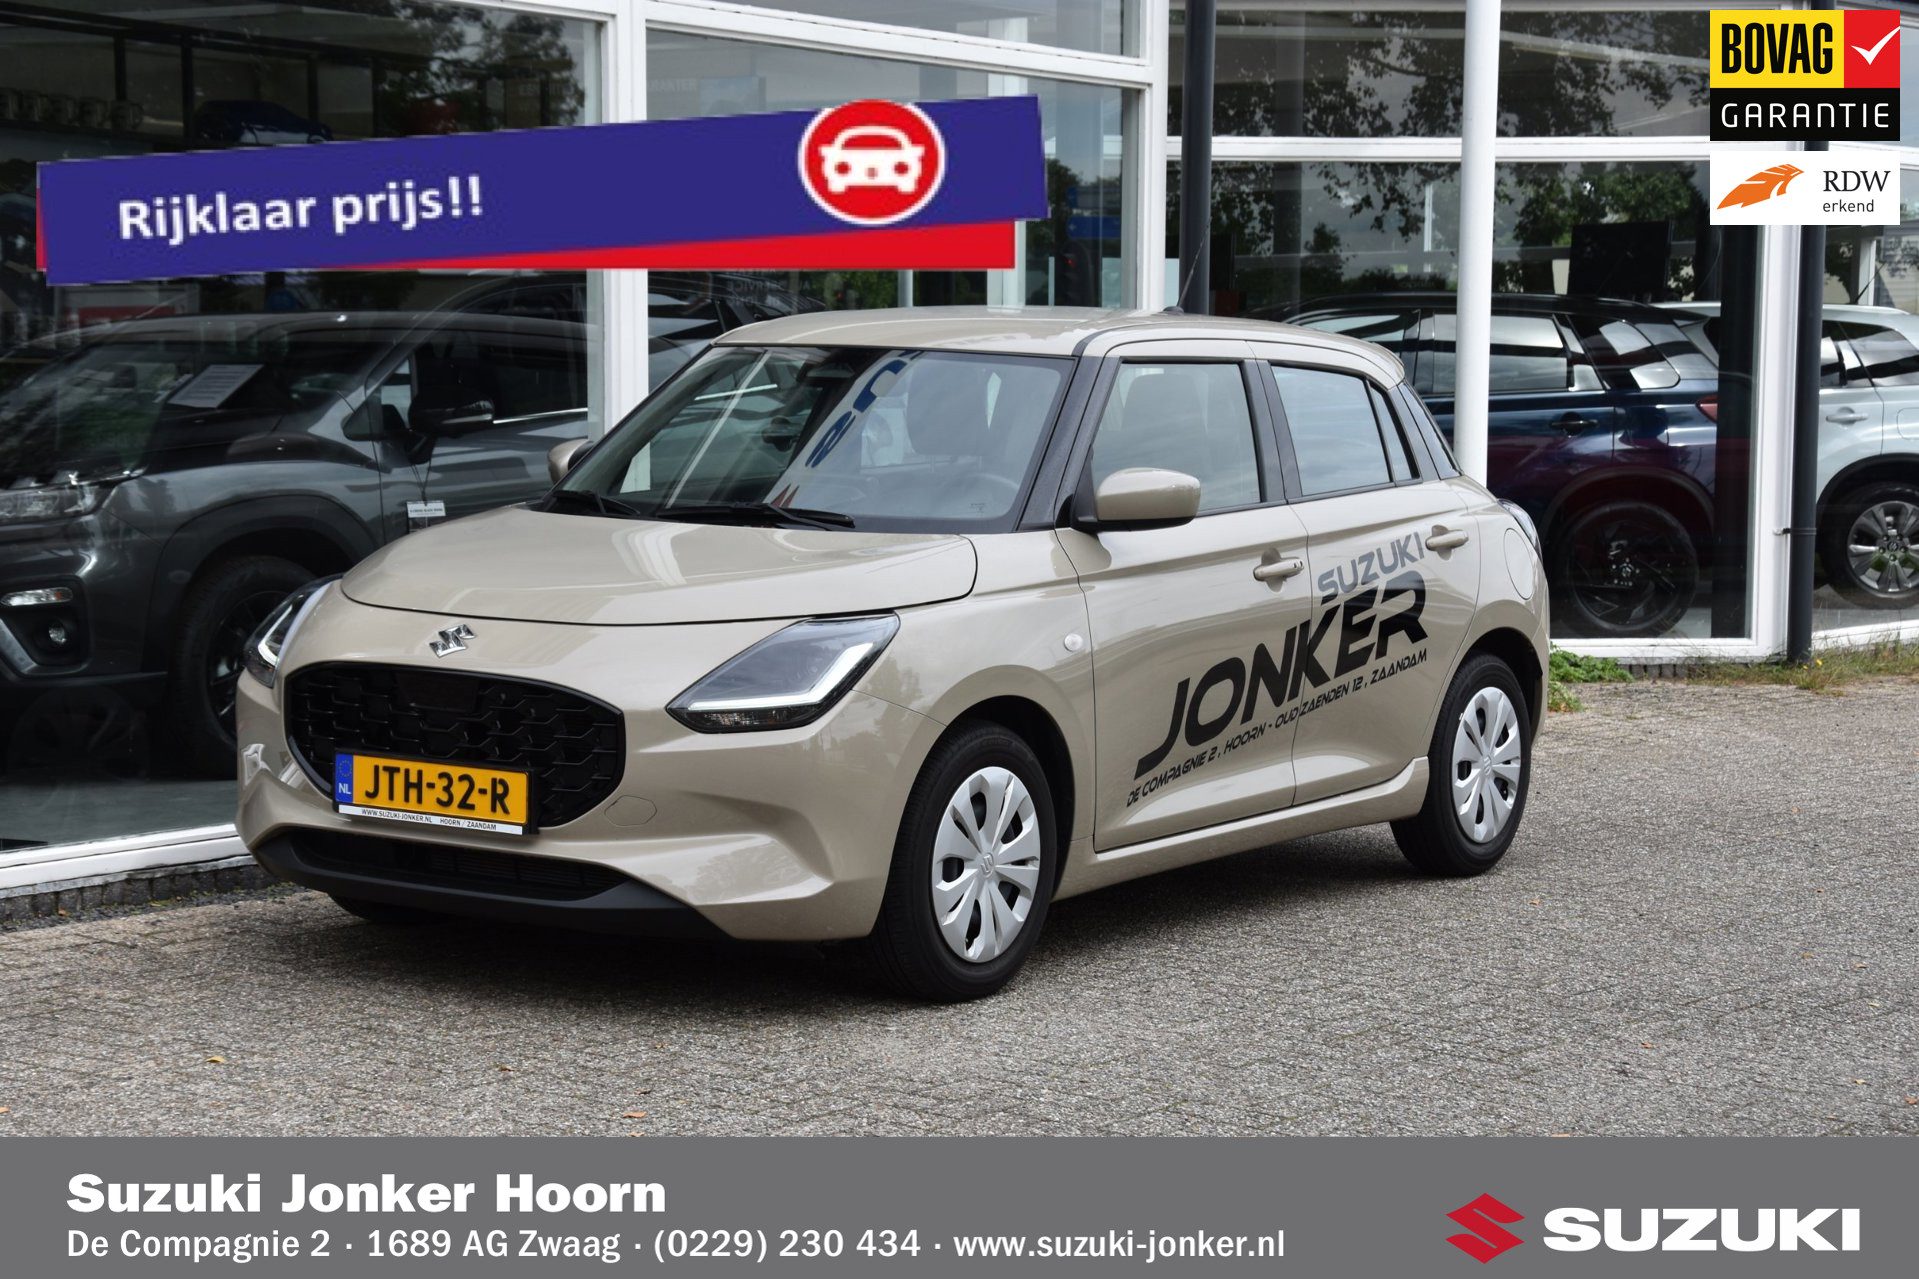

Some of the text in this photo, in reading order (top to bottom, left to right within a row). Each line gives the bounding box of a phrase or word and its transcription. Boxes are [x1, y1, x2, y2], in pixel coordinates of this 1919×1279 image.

[1317, 531, 1424, 606] SUZUKI
[1134, 570, 1428, 781] JONKER
[1126, 786, 1142, 807] DE
[1142, 750, 1207, 798] COMPAGNIE
[1223, 722, 1267, 755] HOORN
[1275, 707, 1299, 729] OUD
[1299, 682, 1350, 717] ZAENDEN
[1370, 648, 1427, 685] ZAANDAM
[338, 782, 352, 795] NL
[361, 808, 433, 824] WWW.SUZUKI-JONKER.NL
[439, 817, 461, 827] HOORN
[466, 820, 497, 831] ZAANDAM
[365, 764, 510, 815] JTH-32-R
